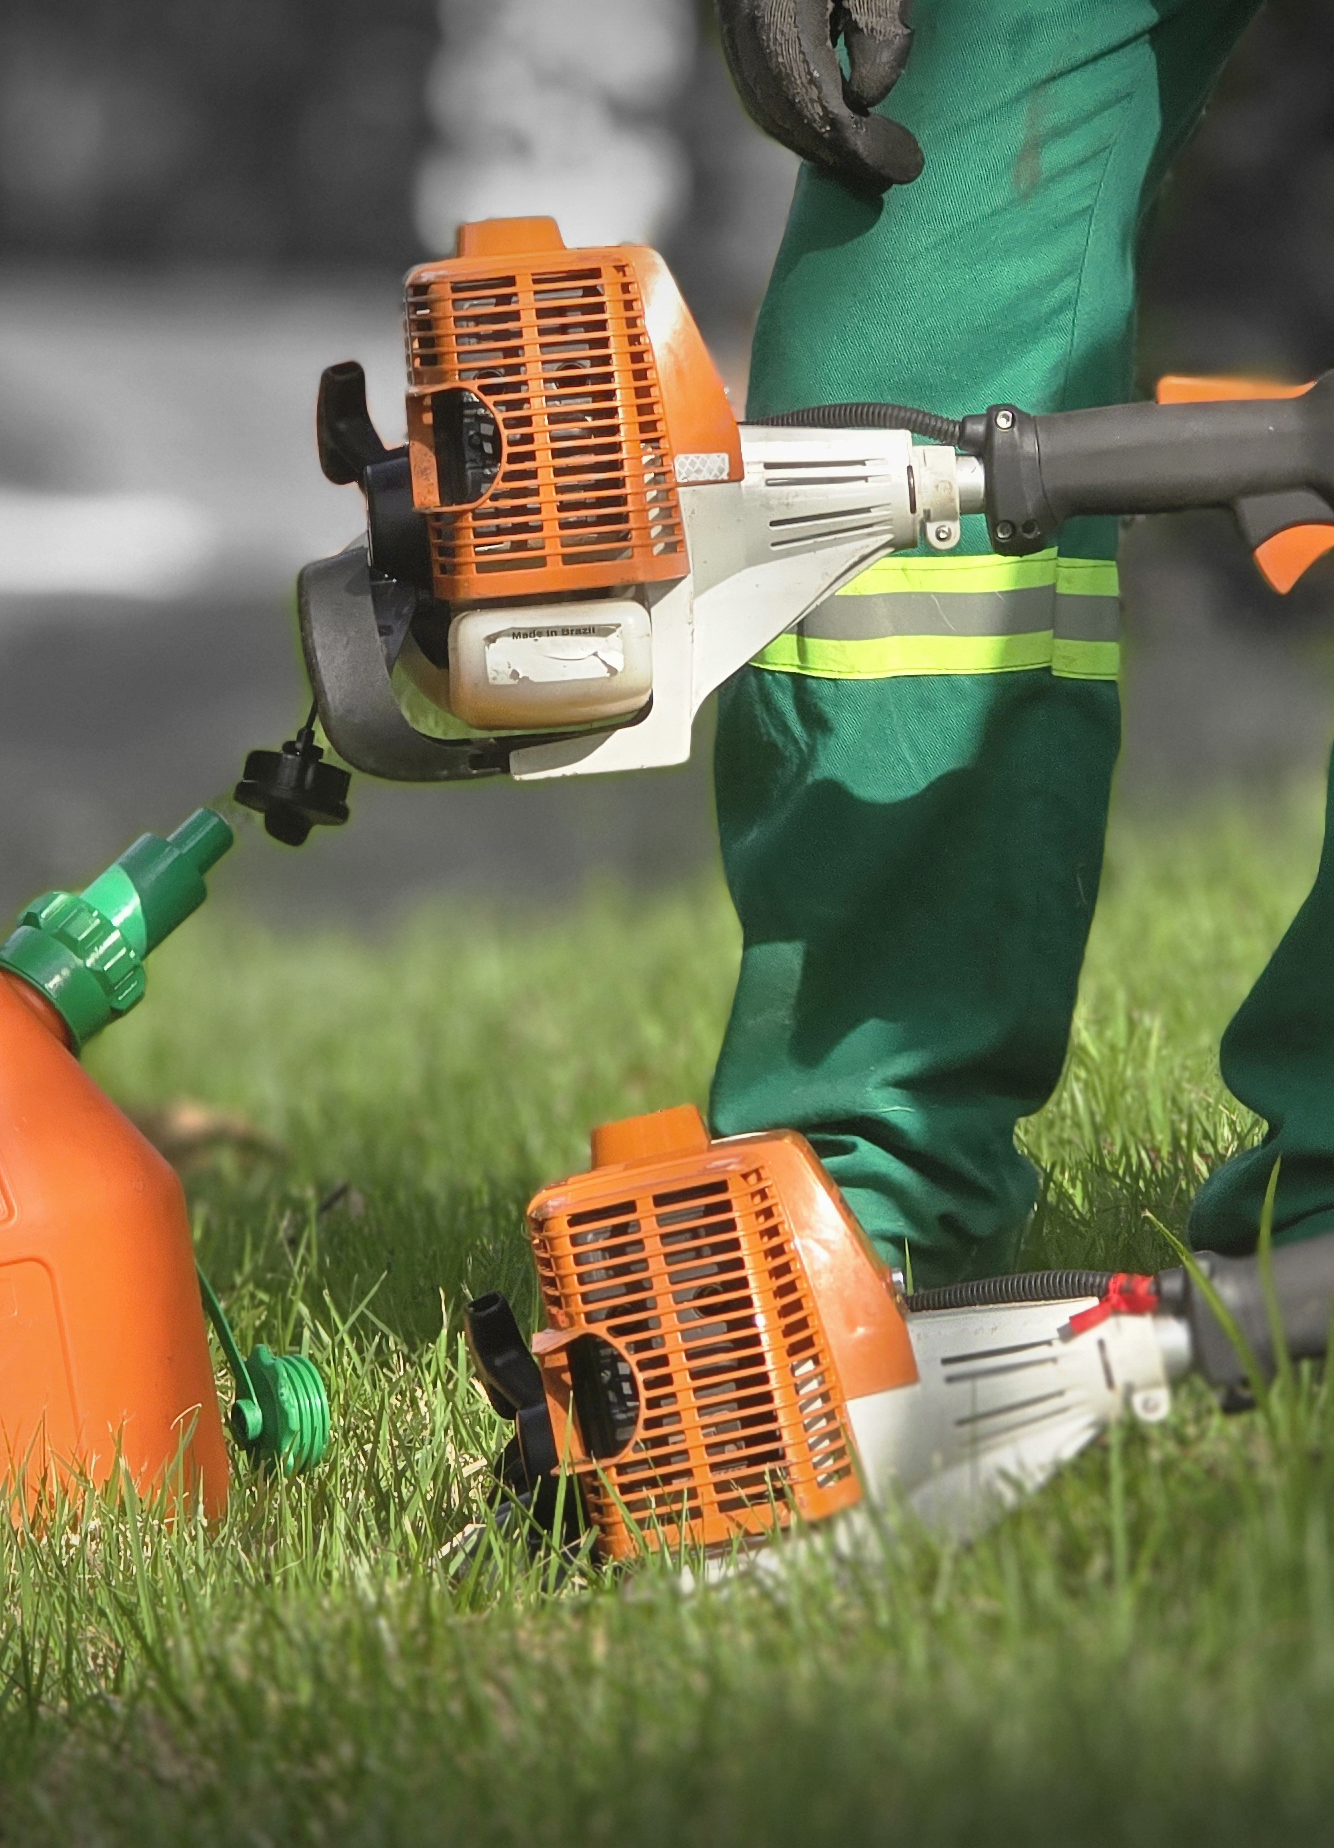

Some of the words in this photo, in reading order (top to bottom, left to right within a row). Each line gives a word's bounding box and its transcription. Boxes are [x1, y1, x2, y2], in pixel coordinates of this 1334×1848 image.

[512, 630, 543, 640] Made
[546, 629, 558, 637] in
[561, 626, 596, 637] Brazil
